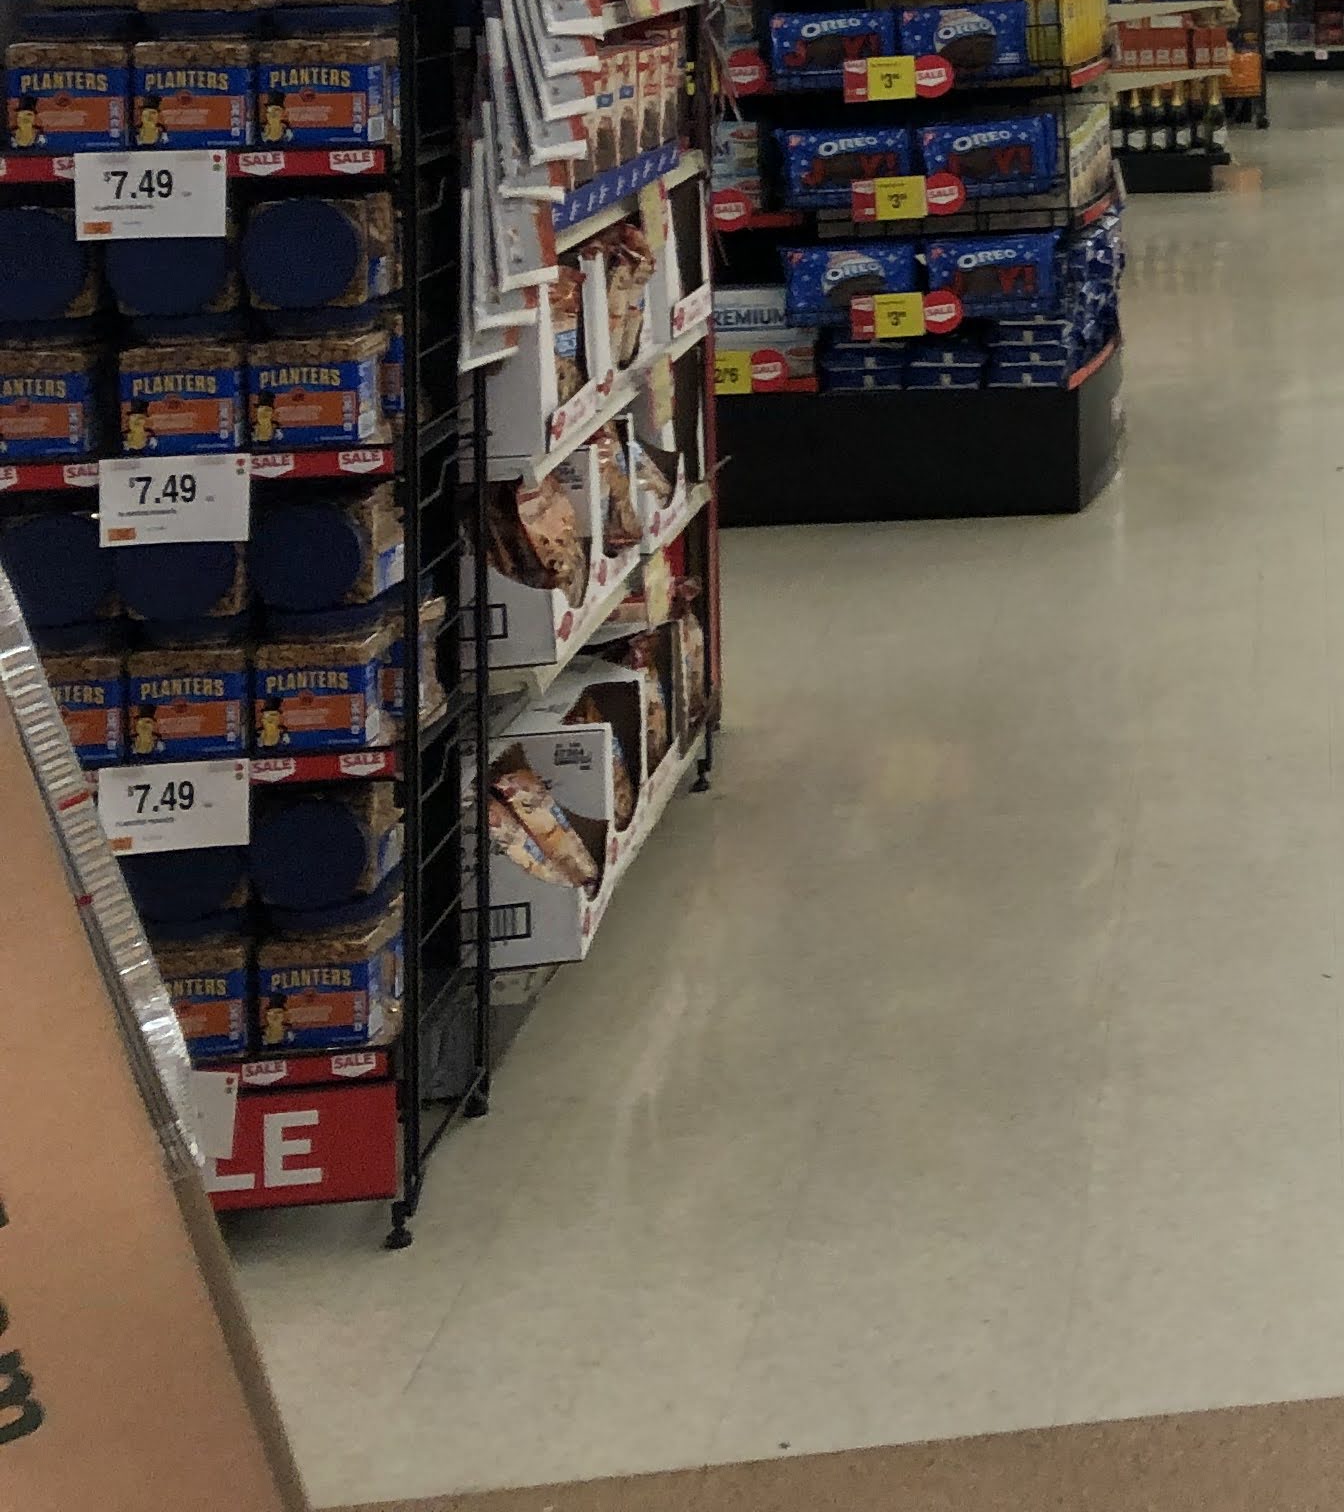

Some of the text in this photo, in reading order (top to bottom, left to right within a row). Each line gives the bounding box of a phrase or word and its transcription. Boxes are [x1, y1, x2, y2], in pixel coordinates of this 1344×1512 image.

[801, 19, 860, 38] OREO
[938, 23, 990, 39] OREO
[21, 71, 108, 91] PLANTERS
[145, 71, 229, 91] PLANTERS
[270, 67, 350, 88] PLANTERS
[918, 71, 944, 80] SALE
[818, 137, 877, 156] OREO
[953, 131, 1010, 151] OREO
[241, 152, 282, 167] SALE
[333, 151, 371, 165] SALE
[104, 170, 173, 199] $7.49
[957, 249, 1016, 268] OREO
[826, 262, 878, 280] OREO
[714, 309, 785, 326] REMIUM
[133, 375, 216, 394] PLANTERS
[259, 367, 340, 388] PLANTERS
[3, 379, 66, 398] ANTERS
[251, 455, 294, 469] SALE
[342, 450, 381, 464] SALE
[66, 465, 99, 479] SAL
[129, 474, 196, 504] $7.49
[140, 677, 224, 699] PLANTERS
[266, 672, 348, 694] PLANTERS
[253, 758, 294, 774] SALE
[342, 754, 381, 768] SALE
[127, 781, 195, 814] $7.49
[271, 968, 351, 989] PLANTERS
[245, 1062, 284, 1078] SALE
[334, 1054, 374, 1069] SALE
